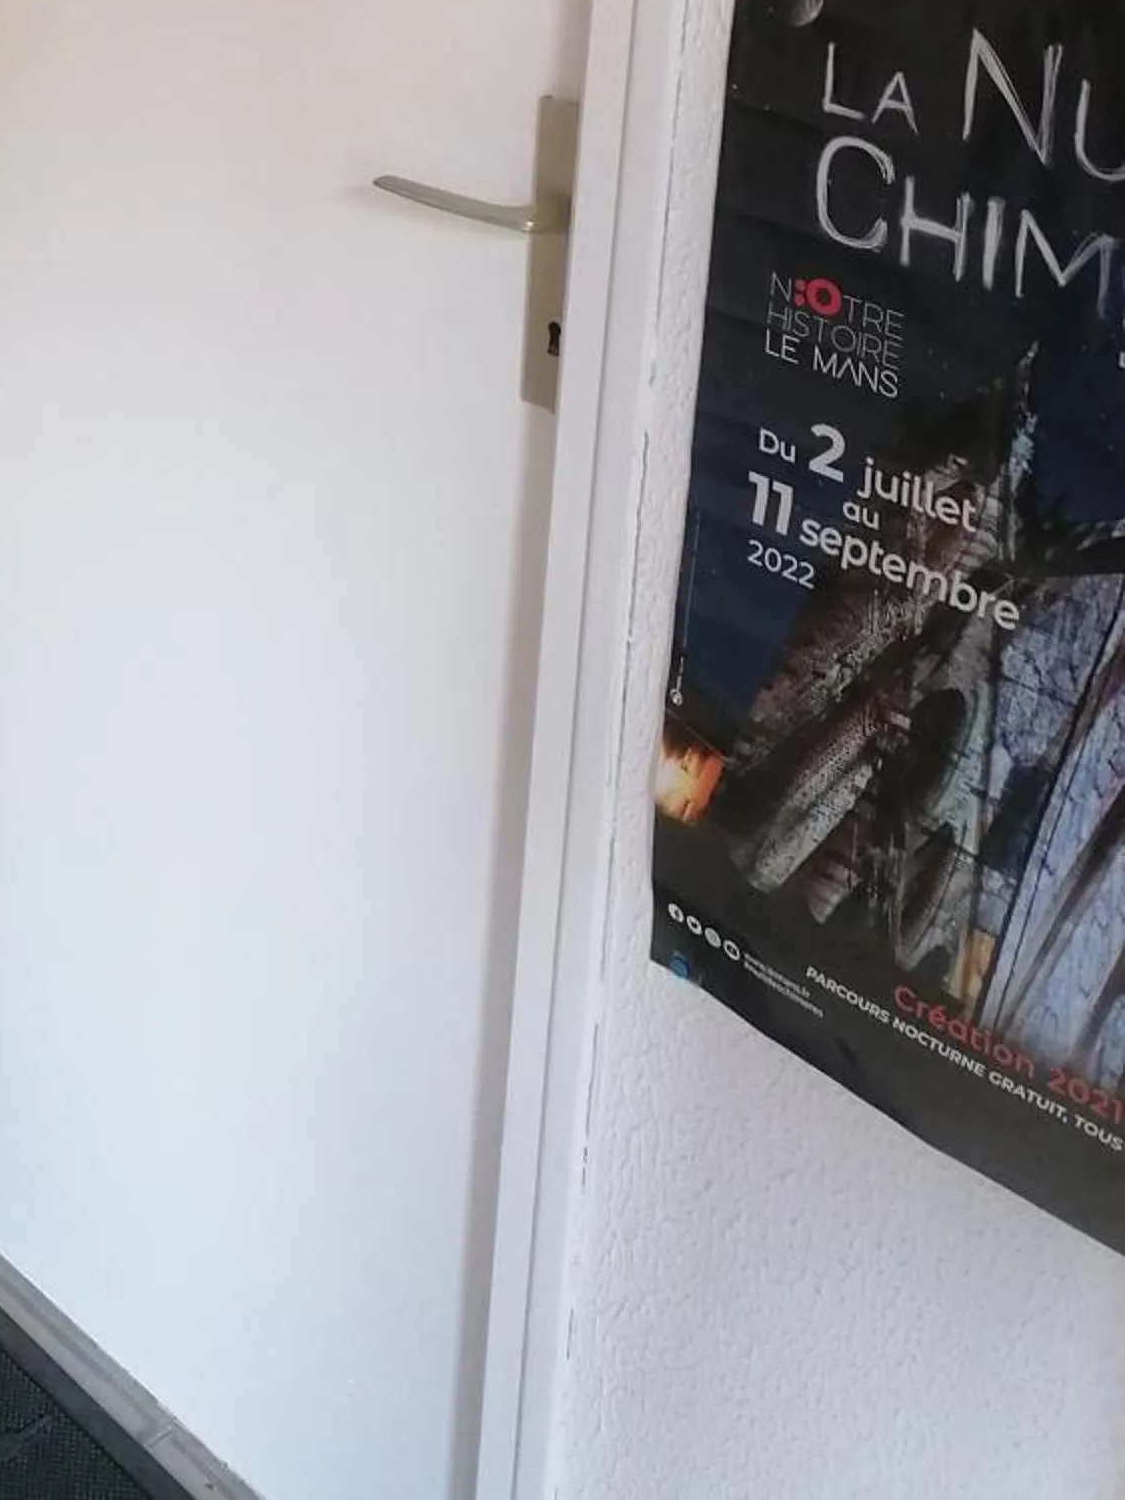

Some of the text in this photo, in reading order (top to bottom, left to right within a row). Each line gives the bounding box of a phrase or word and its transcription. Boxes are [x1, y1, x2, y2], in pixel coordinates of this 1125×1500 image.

[823, 42, 920, 135] LA
[765, 329, 899, 399] LE MANS
[767, 301, 905, 371] HISTOIRE
[758, 423, 983, 533] Du 2 juillet
[842, 501, 880, 531] au
[747, 470, 1021, 631] 11 septembre
[747, 538, 816, 590] 2022
[805, 964, 890, 1024] PARCOURS
[892, 1016, 985, 1078] NOCTURNE
[1074, 1113, 1125, 1152] TOUS
[893, 984, 1036, 1079] Création
[1048, 1066, 1125, 1127] 2021
